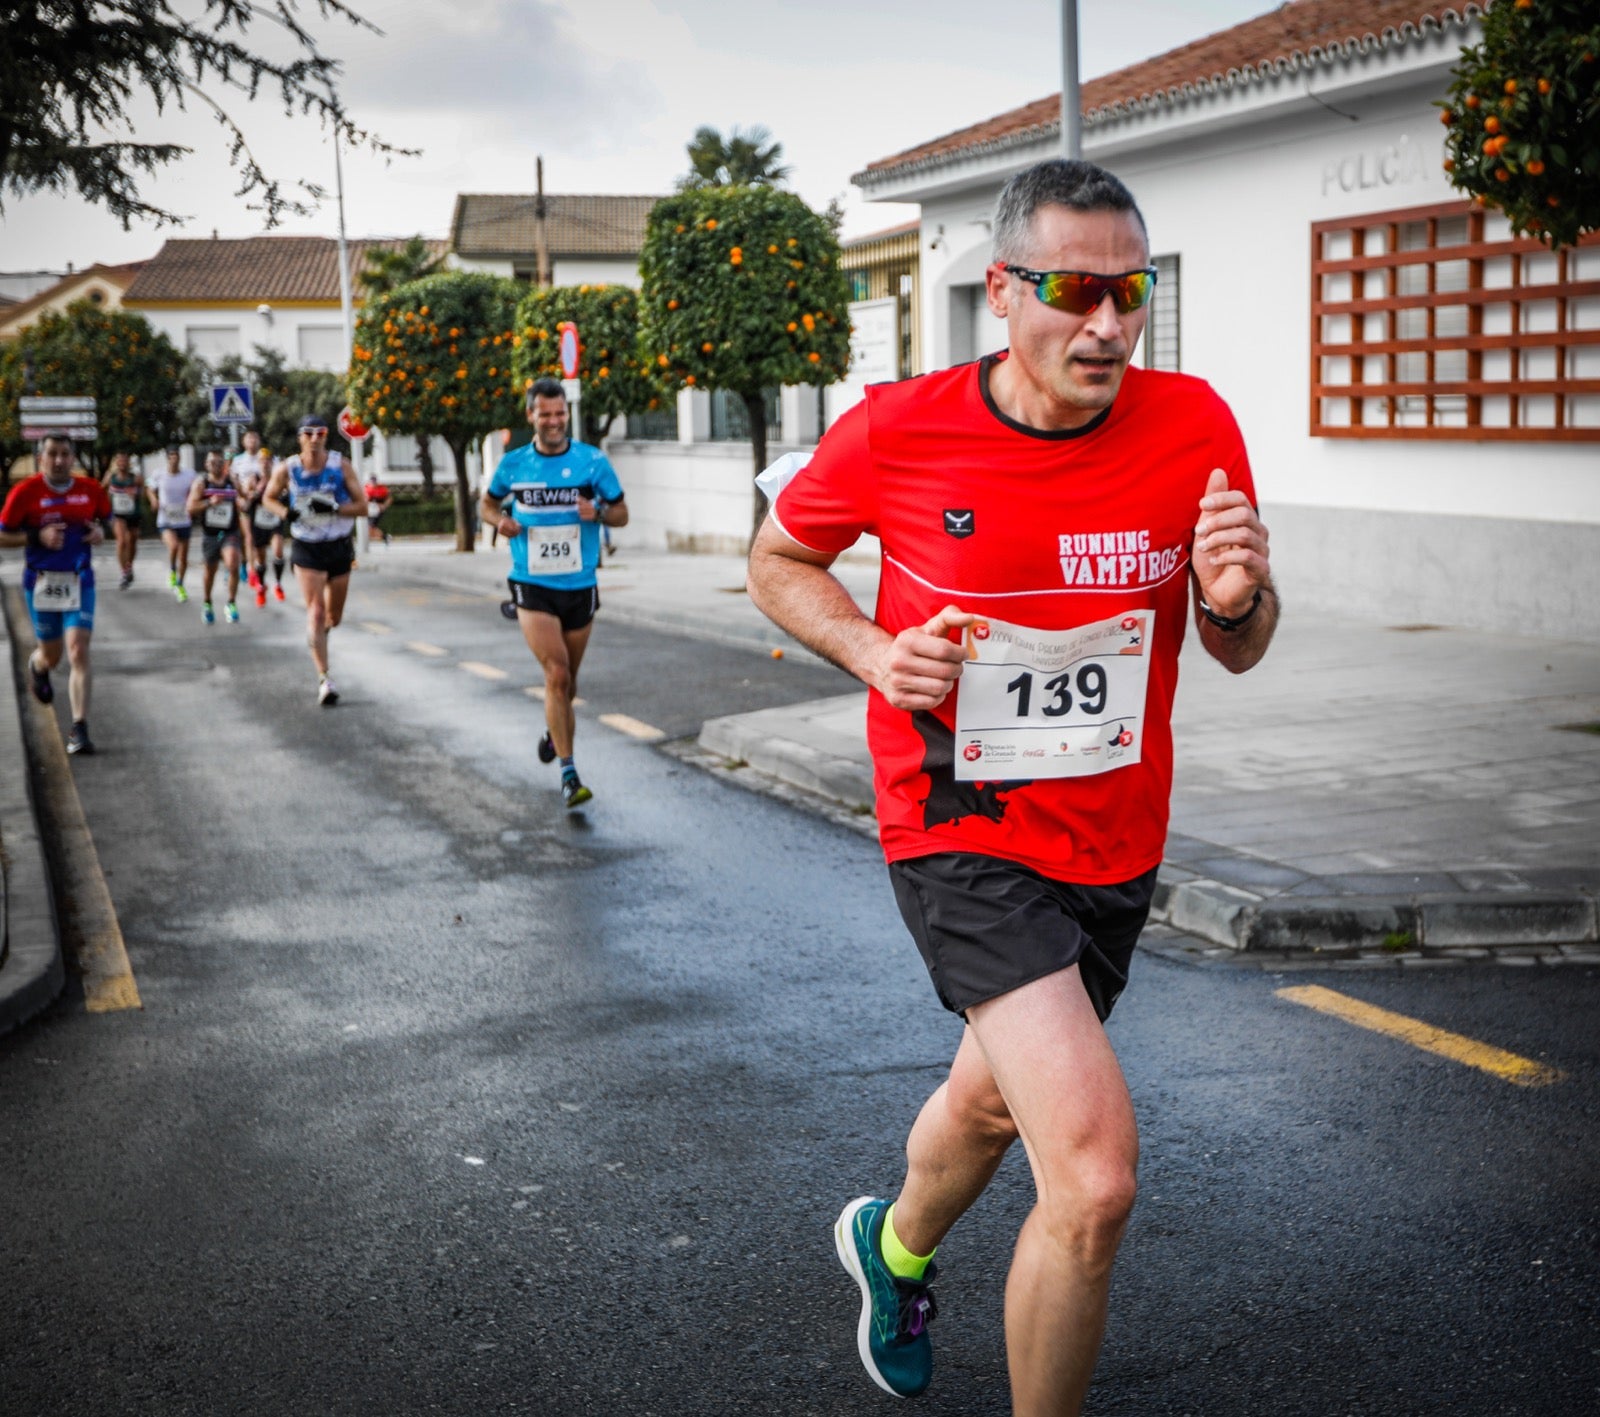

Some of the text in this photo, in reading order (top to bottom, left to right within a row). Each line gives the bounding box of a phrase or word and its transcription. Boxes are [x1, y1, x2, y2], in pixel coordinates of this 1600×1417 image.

[541, 541, 571, 558] 259
[1058, 530, 1150, 556] RUNNING
[1059, 544, 1182, 585] VAMPIROS
[1007, 663, 1108, 718] 139
